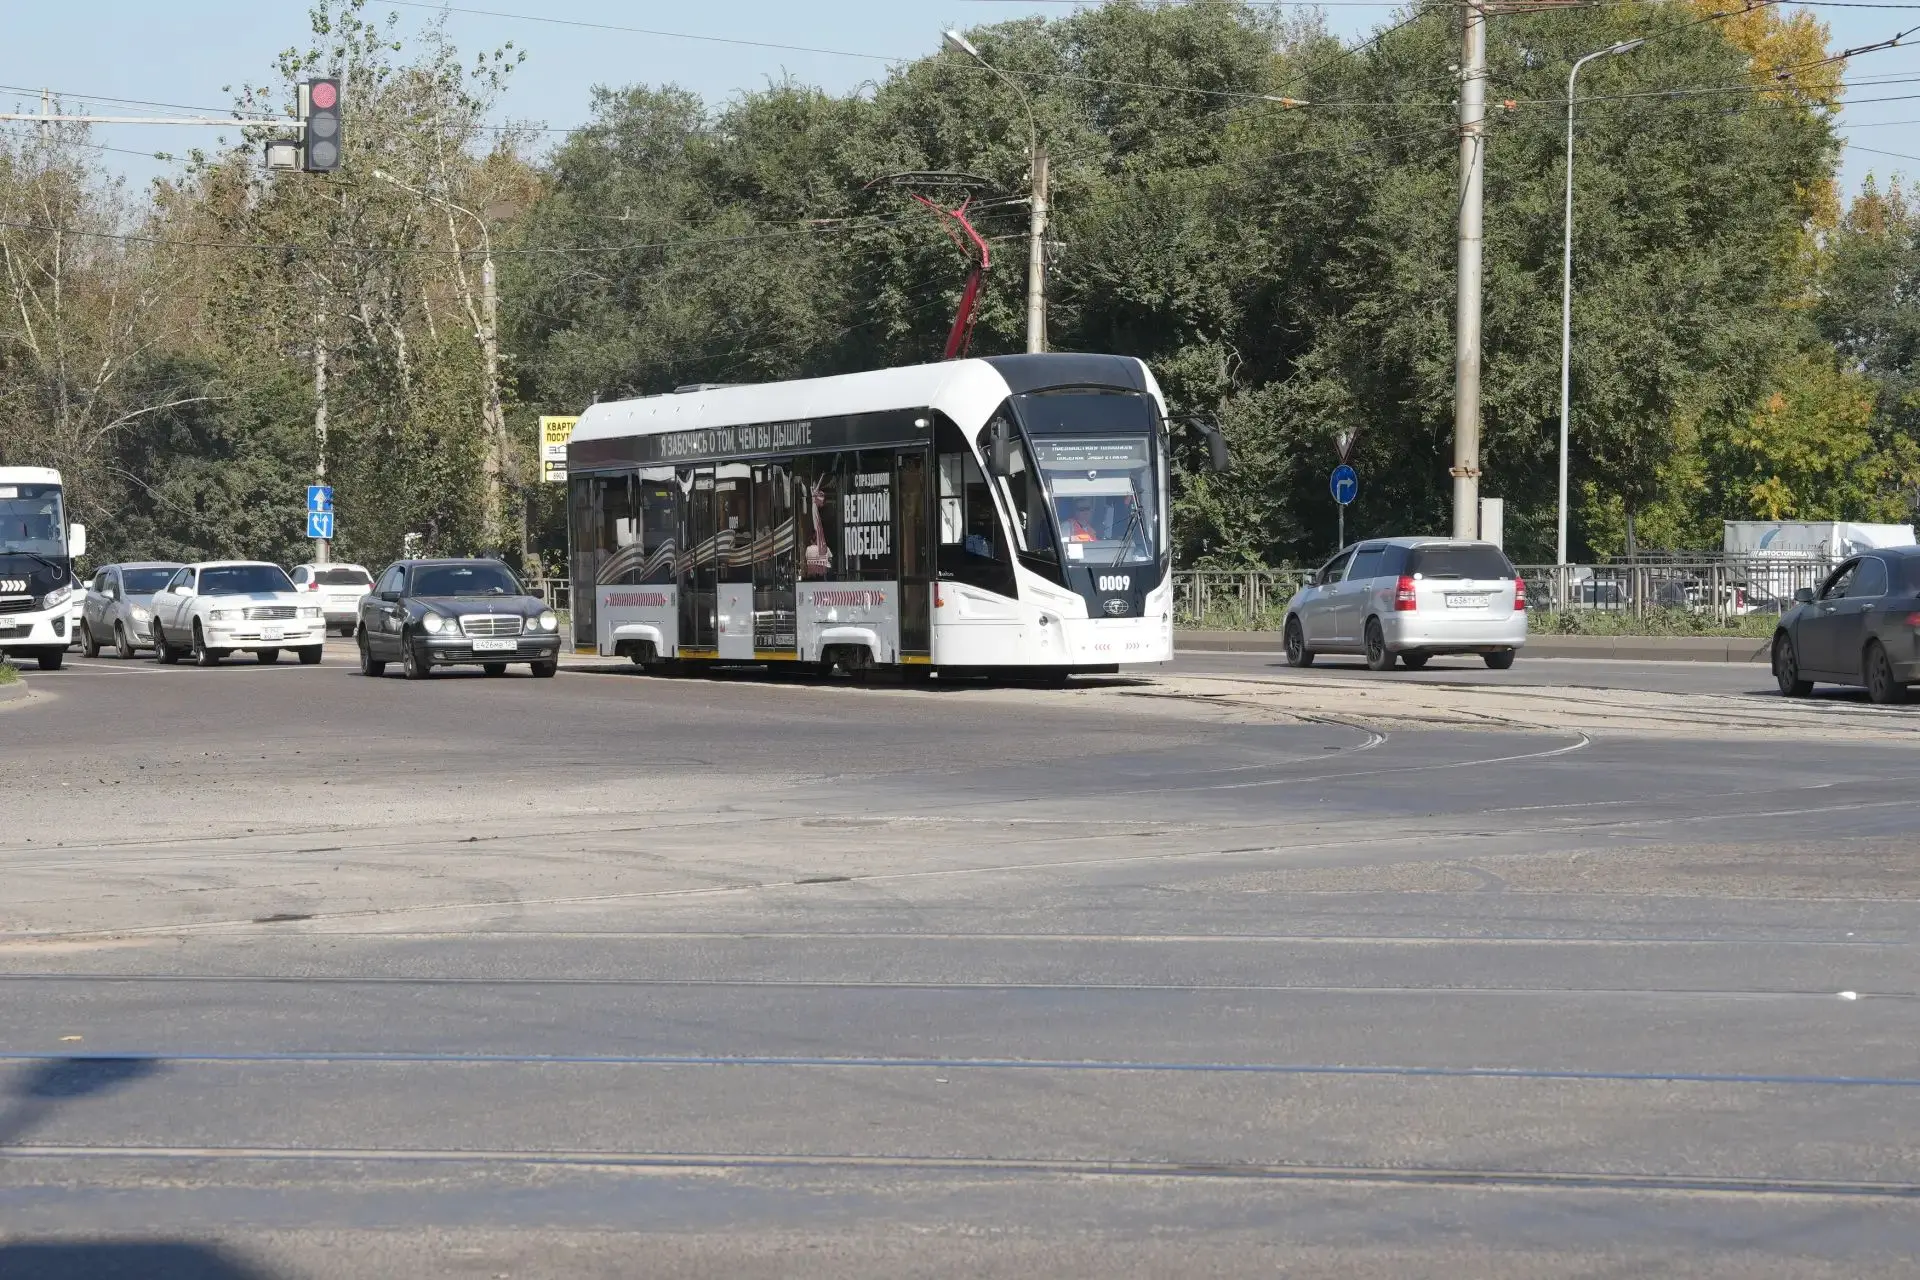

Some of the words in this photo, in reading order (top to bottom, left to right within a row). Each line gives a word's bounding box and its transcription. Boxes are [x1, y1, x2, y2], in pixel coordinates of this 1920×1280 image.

[661, 437, 666, 457] Я
[710, 433, 716, 452] О
[717, 430, 737, 454] ТОМ,
[739, 428, 756, 450] ЧЕМ
[758, 425, 771, 448] ВЫ
[773, 421, 812, 450] ДЫШИТЕ
[844, 488, 890, 523] ВЕЛИКОЙ
[845, 525, 890, 560] ПОБЕДЫ!
[1100, 575, 1130, 591] 0009
